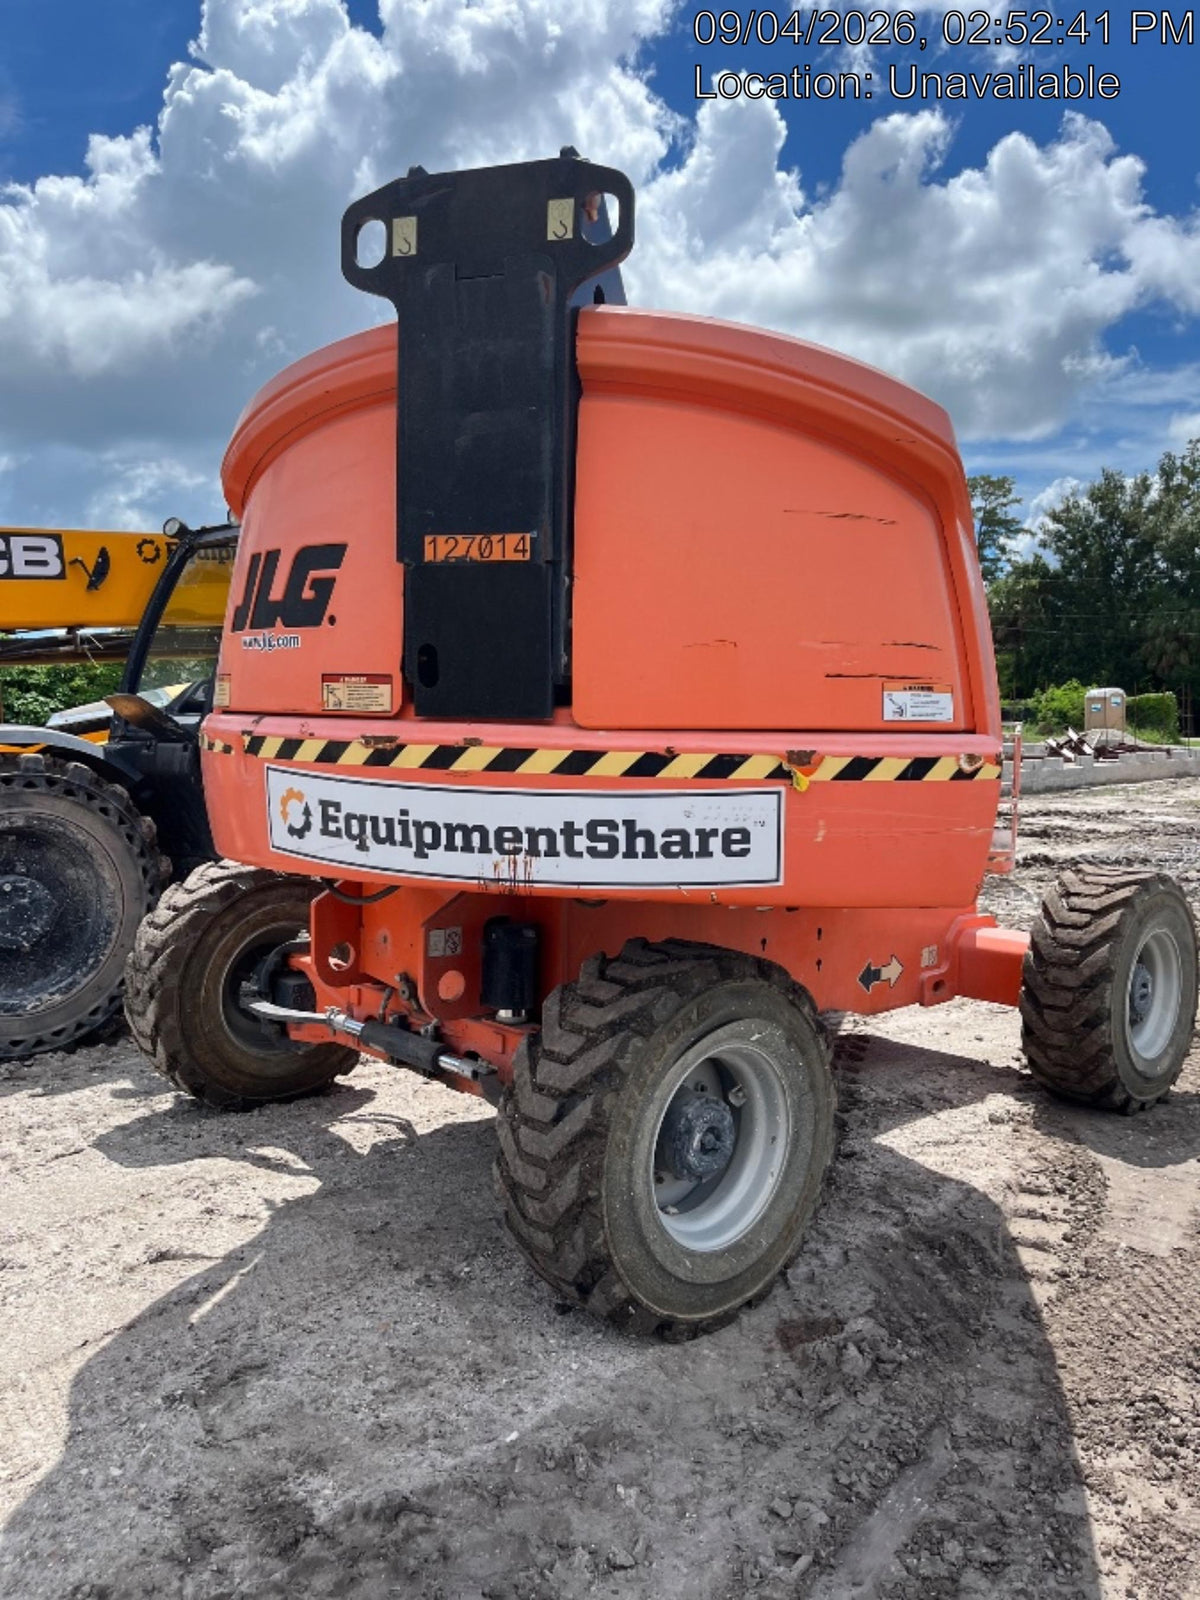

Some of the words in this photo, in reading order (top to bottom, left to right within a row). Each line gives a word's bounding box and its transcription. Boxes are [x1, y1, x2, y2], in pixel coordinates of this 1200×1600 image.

[0, 537, 63, 576] B
[428, 534, 528, 560] 127014
[231, 543, 348, 633] JLG
[318, 798, 752, 859] EquipmentShare
